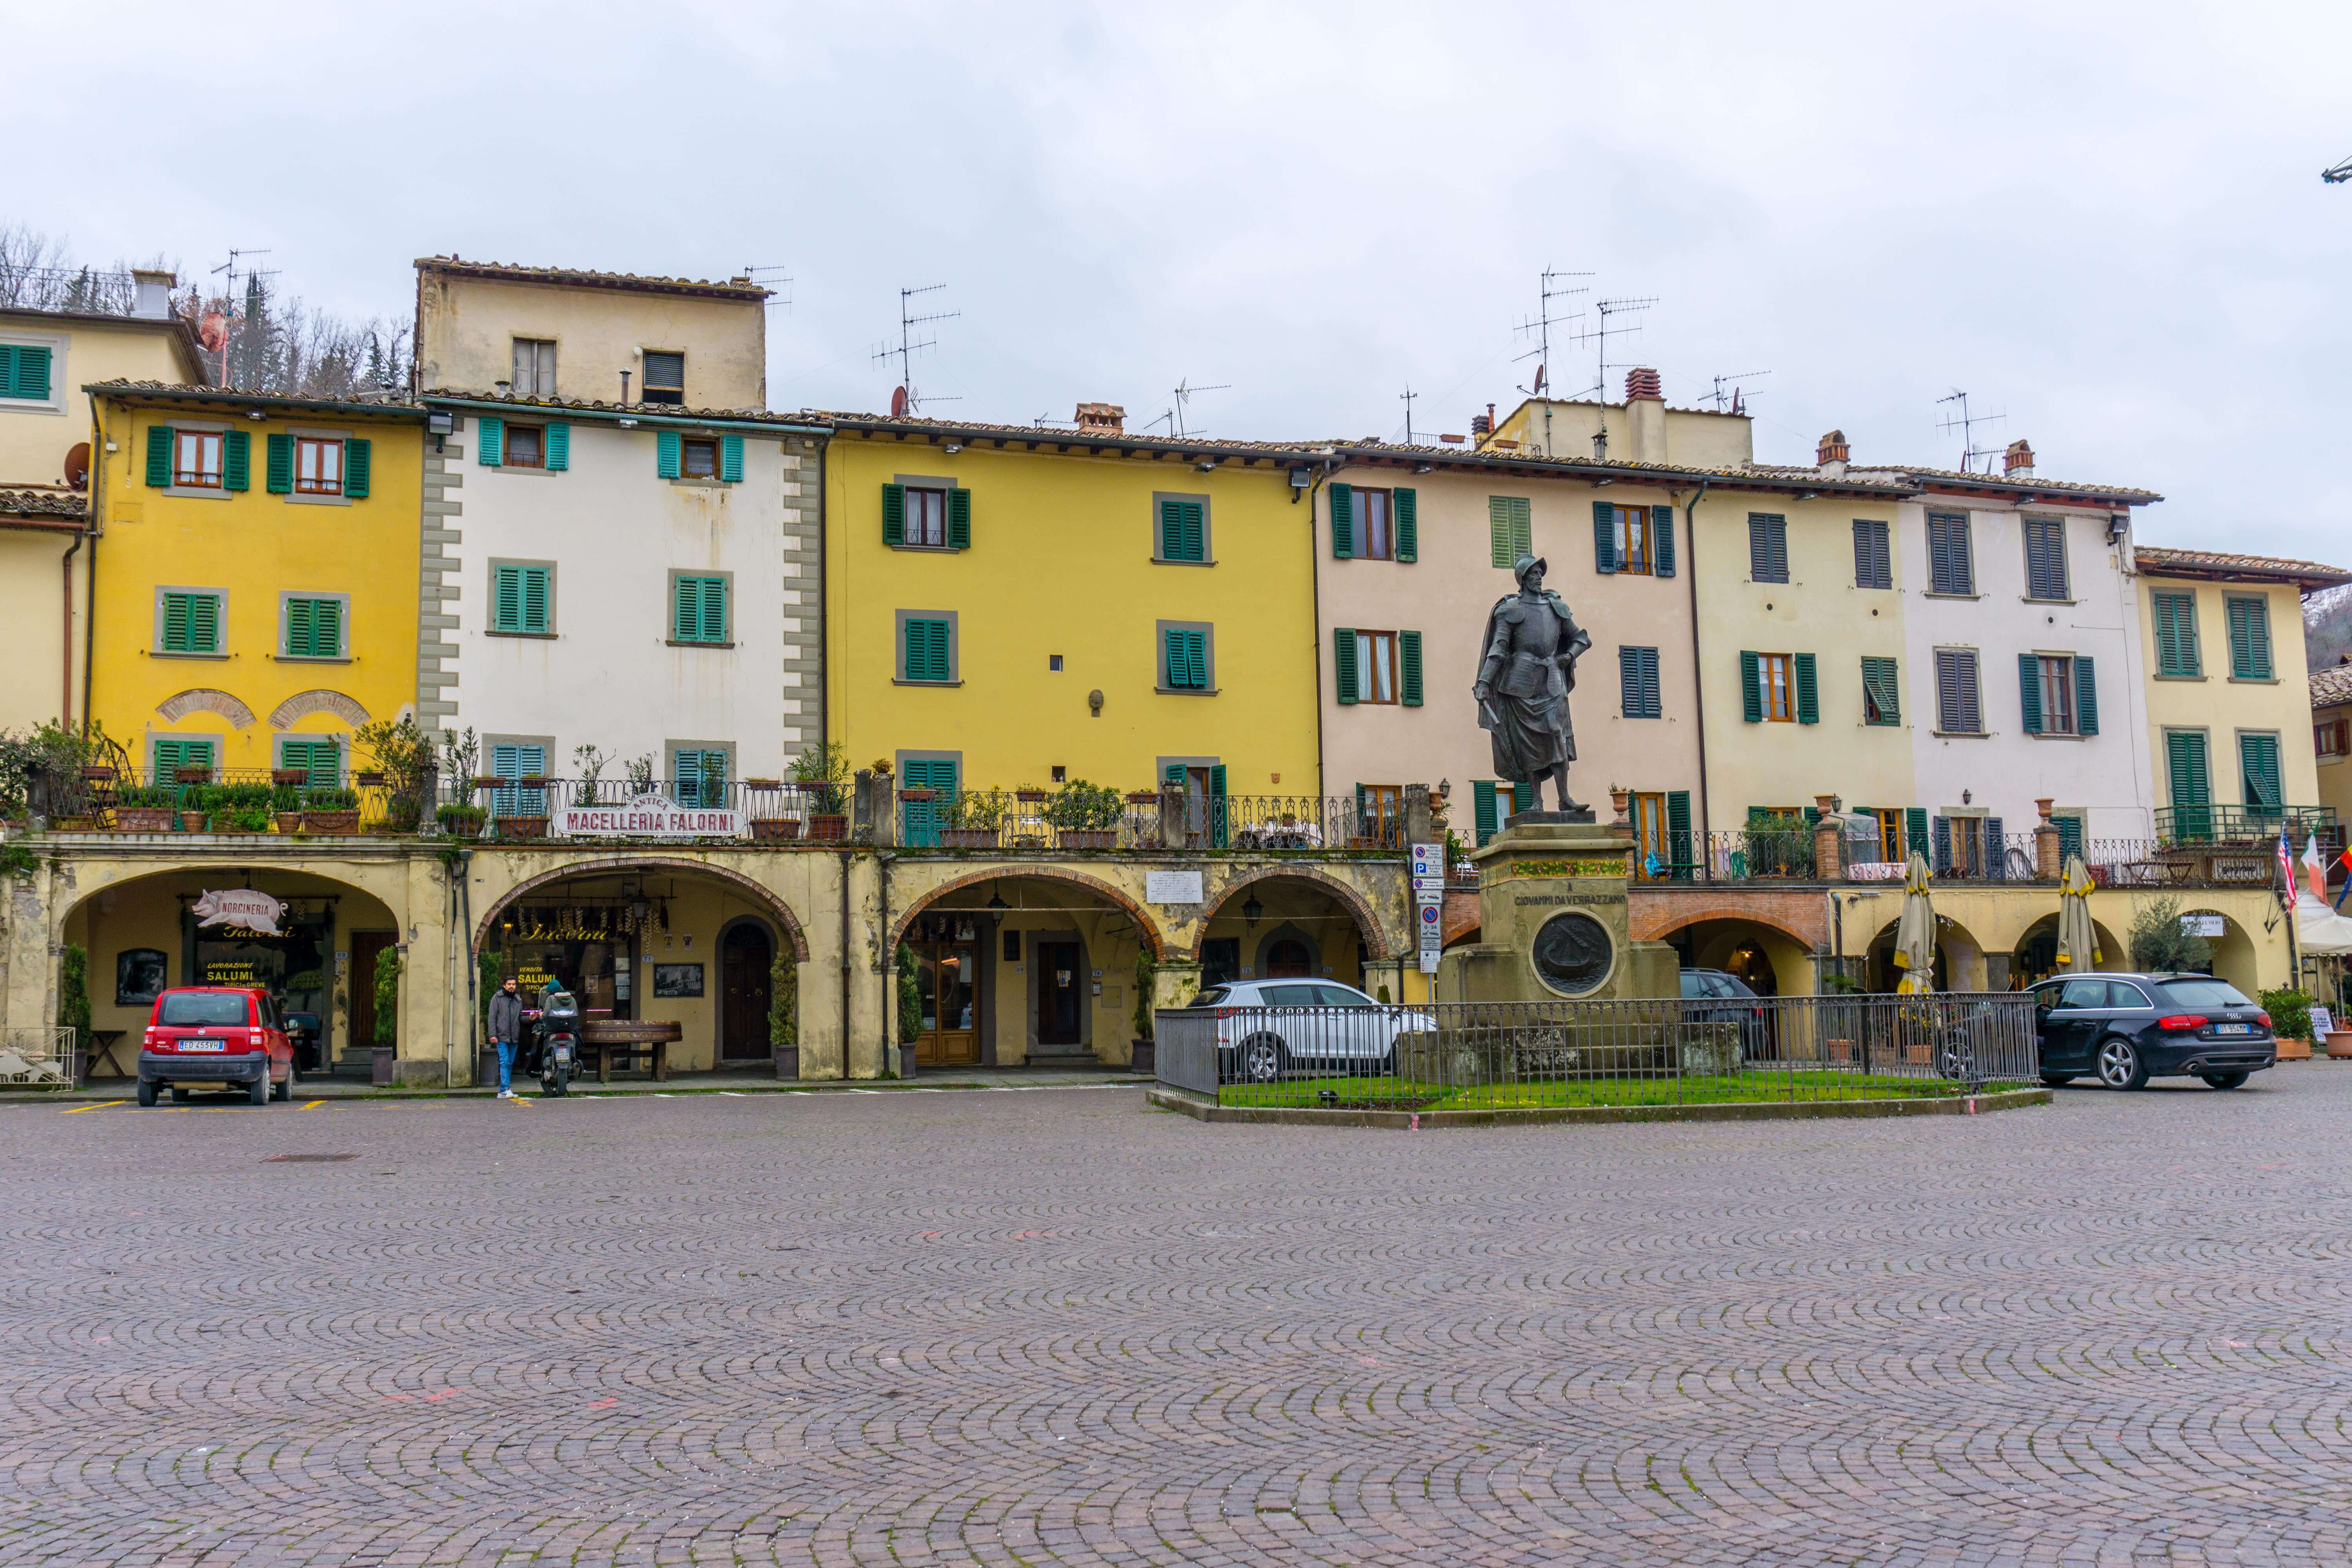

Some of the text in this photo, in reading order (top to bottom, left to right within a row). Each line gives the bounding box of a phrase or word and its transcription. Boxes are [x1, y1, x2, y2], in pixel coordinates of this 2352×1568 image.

[633, 797, 668, 811] ANTICA
[567, 812, 734, 831] MACELLERIA FALORNI
[1417, 864, 1424, 873] P
[1568, 882, 1573, 891] A
[1514, 895, 1626, 906] GIOVANNI DA VERRAZZANO
[222, 902, 269, 915] NORCINERIA
[223, 926, 296, 938] Faloi
[207, 971, 253, 980] SALUMI
[518, 975, 556, 983] SALUMI
